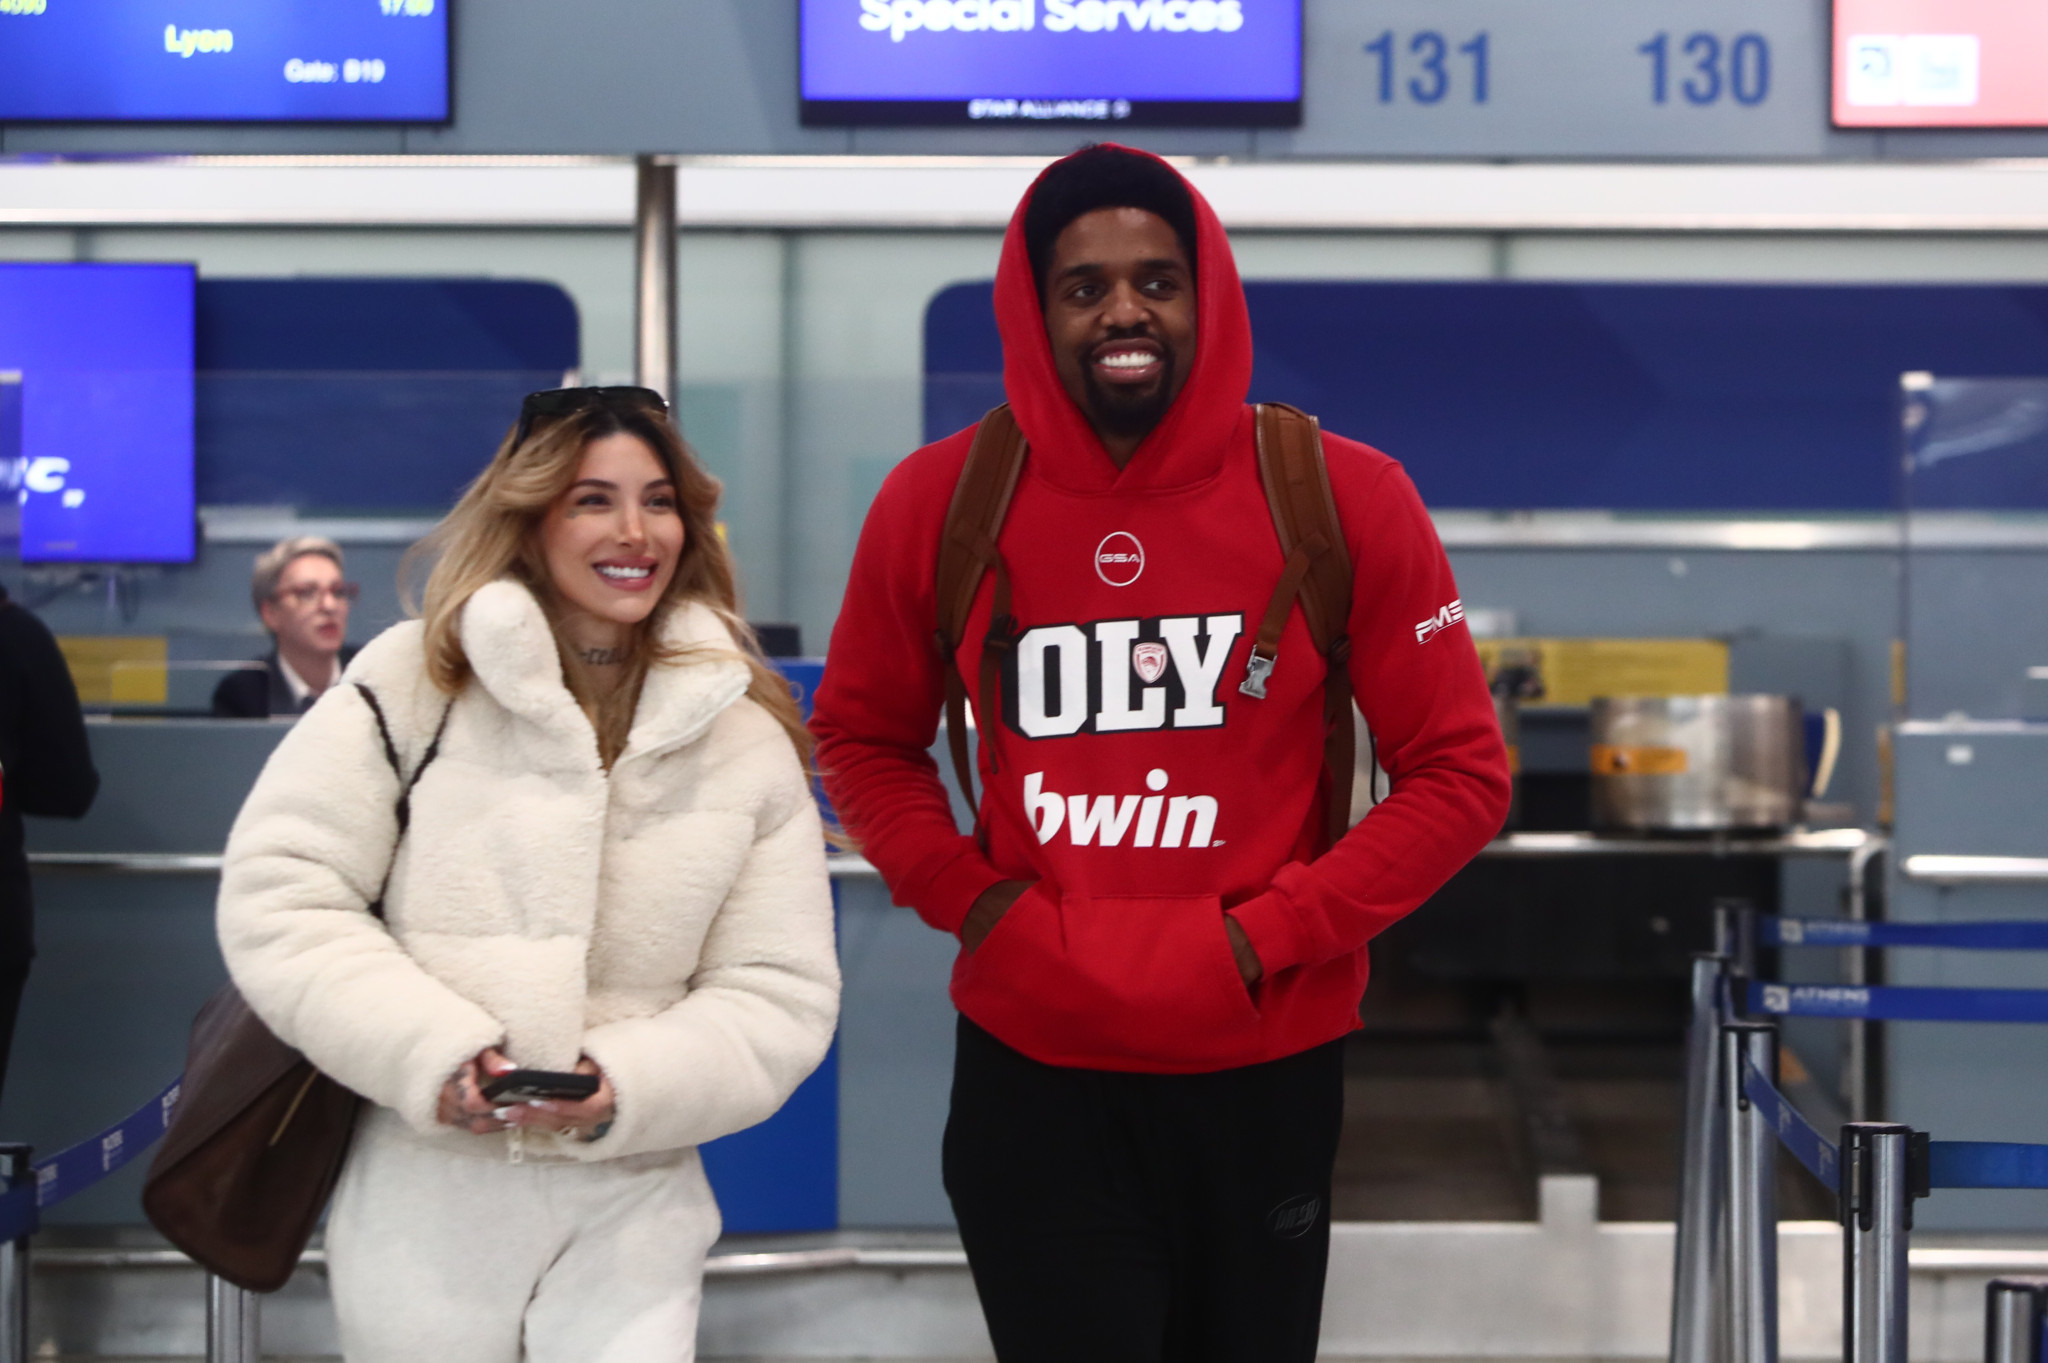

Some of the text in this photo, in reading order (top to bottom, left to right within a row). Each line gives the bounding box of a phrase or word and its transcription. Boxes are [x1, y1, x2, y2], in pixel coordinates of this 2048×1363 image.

[165, 24, 234, 58] Lyon
[858, 0, 1244, 42] Special Services
[1363, 31, 1490, 105] 131
[1638, 31, 1771, 105] 130
[1099, 553, 1141, 563] GSA
[1017, 613, 1243, 739] OLY
[1023, 768, 1219, 848] bwin
